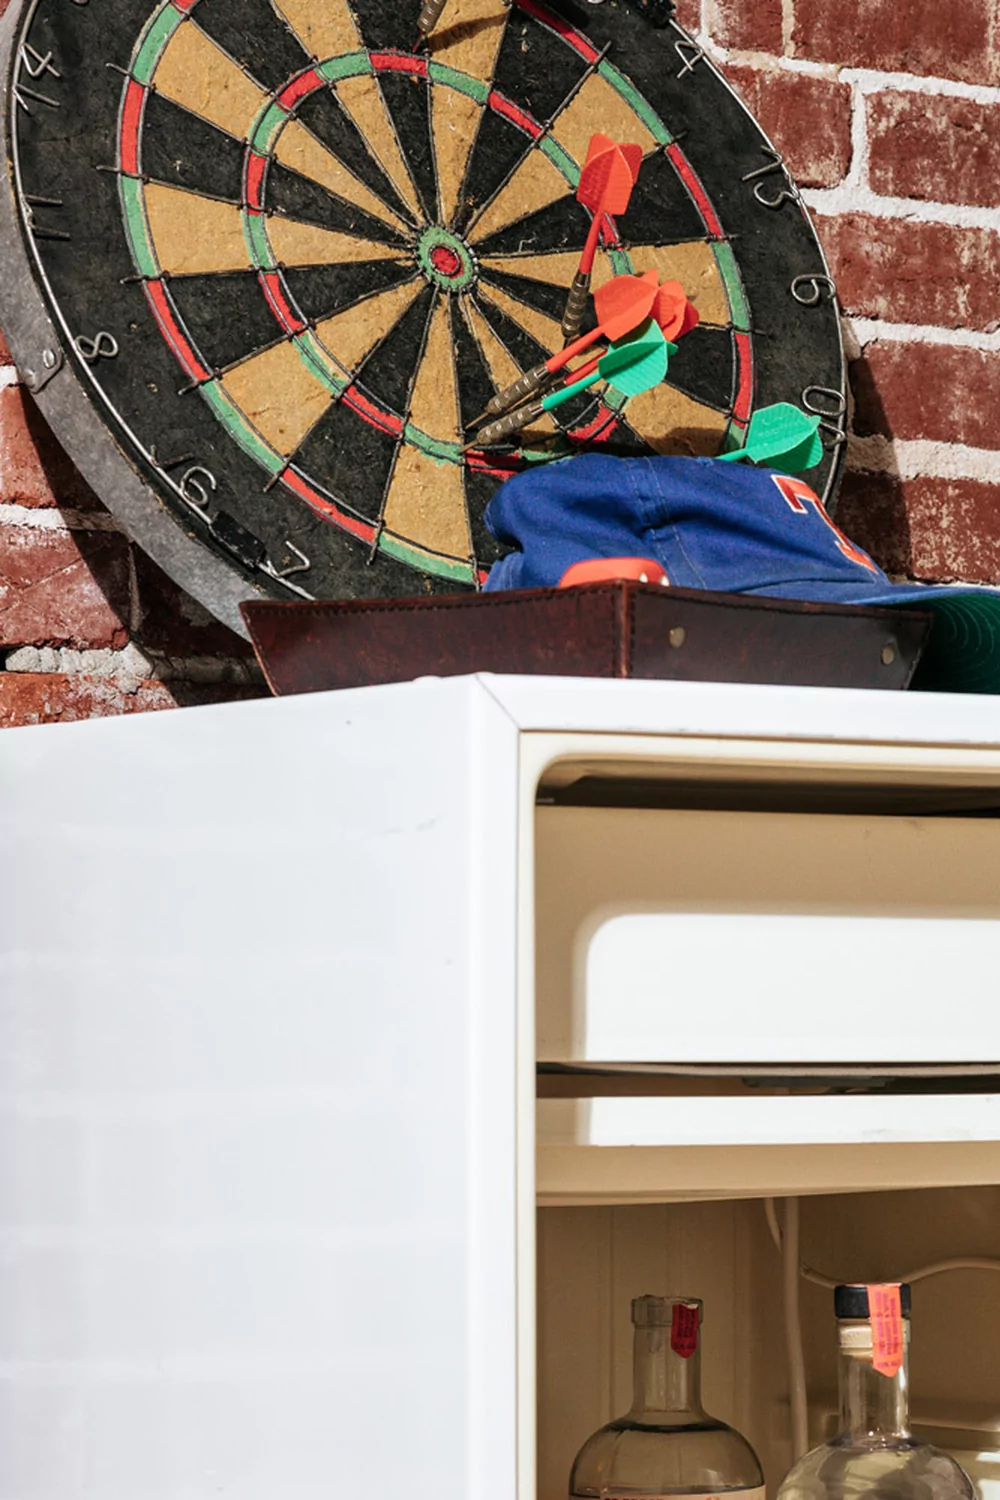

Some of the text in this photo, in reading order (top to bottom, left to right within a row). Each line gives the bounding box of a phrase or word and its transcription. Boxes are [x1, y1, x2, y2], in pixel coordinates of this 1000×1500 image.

[14, 42, 62, 111] 14
[674, 39, 704, 79] 4
[742, 144, 801, 207] 13
[790, 273, 837, 305] 6
[74, 331, 119, 359] 8
[150, 444, 217, 506] 16
